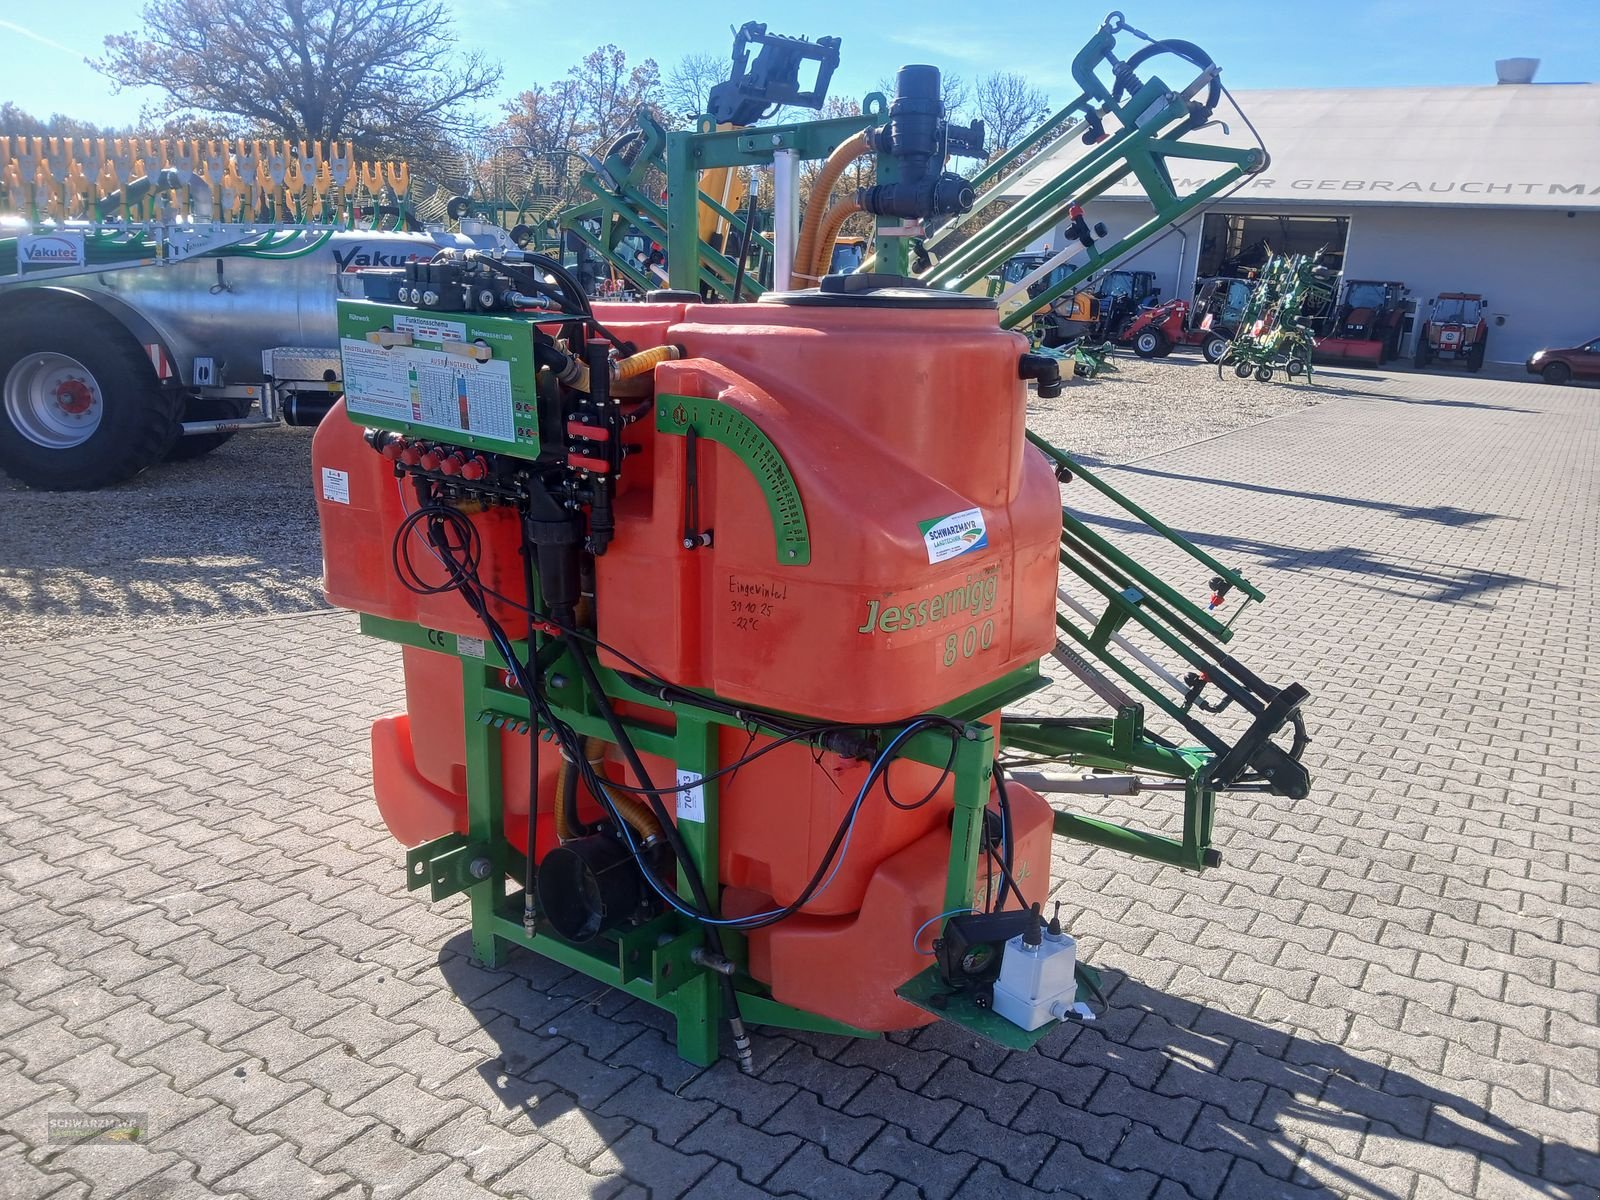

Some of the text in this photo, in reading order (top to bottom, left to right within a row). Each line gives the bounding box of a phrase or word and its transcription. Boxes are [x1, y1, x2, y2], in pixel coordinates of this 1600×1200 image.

[24, 244, 77, 260] Vakutec
[405, 316, 449, 329] Funktionsschema
[471, 328, 513, 341] Reinwassertank
[929, 520, 977, 541] SCHWARZMAYR
[859, 575, 998, 633] Jessernigg
[943, 619, 994, 666] 800
[683, 775, 693, 809] 7043
